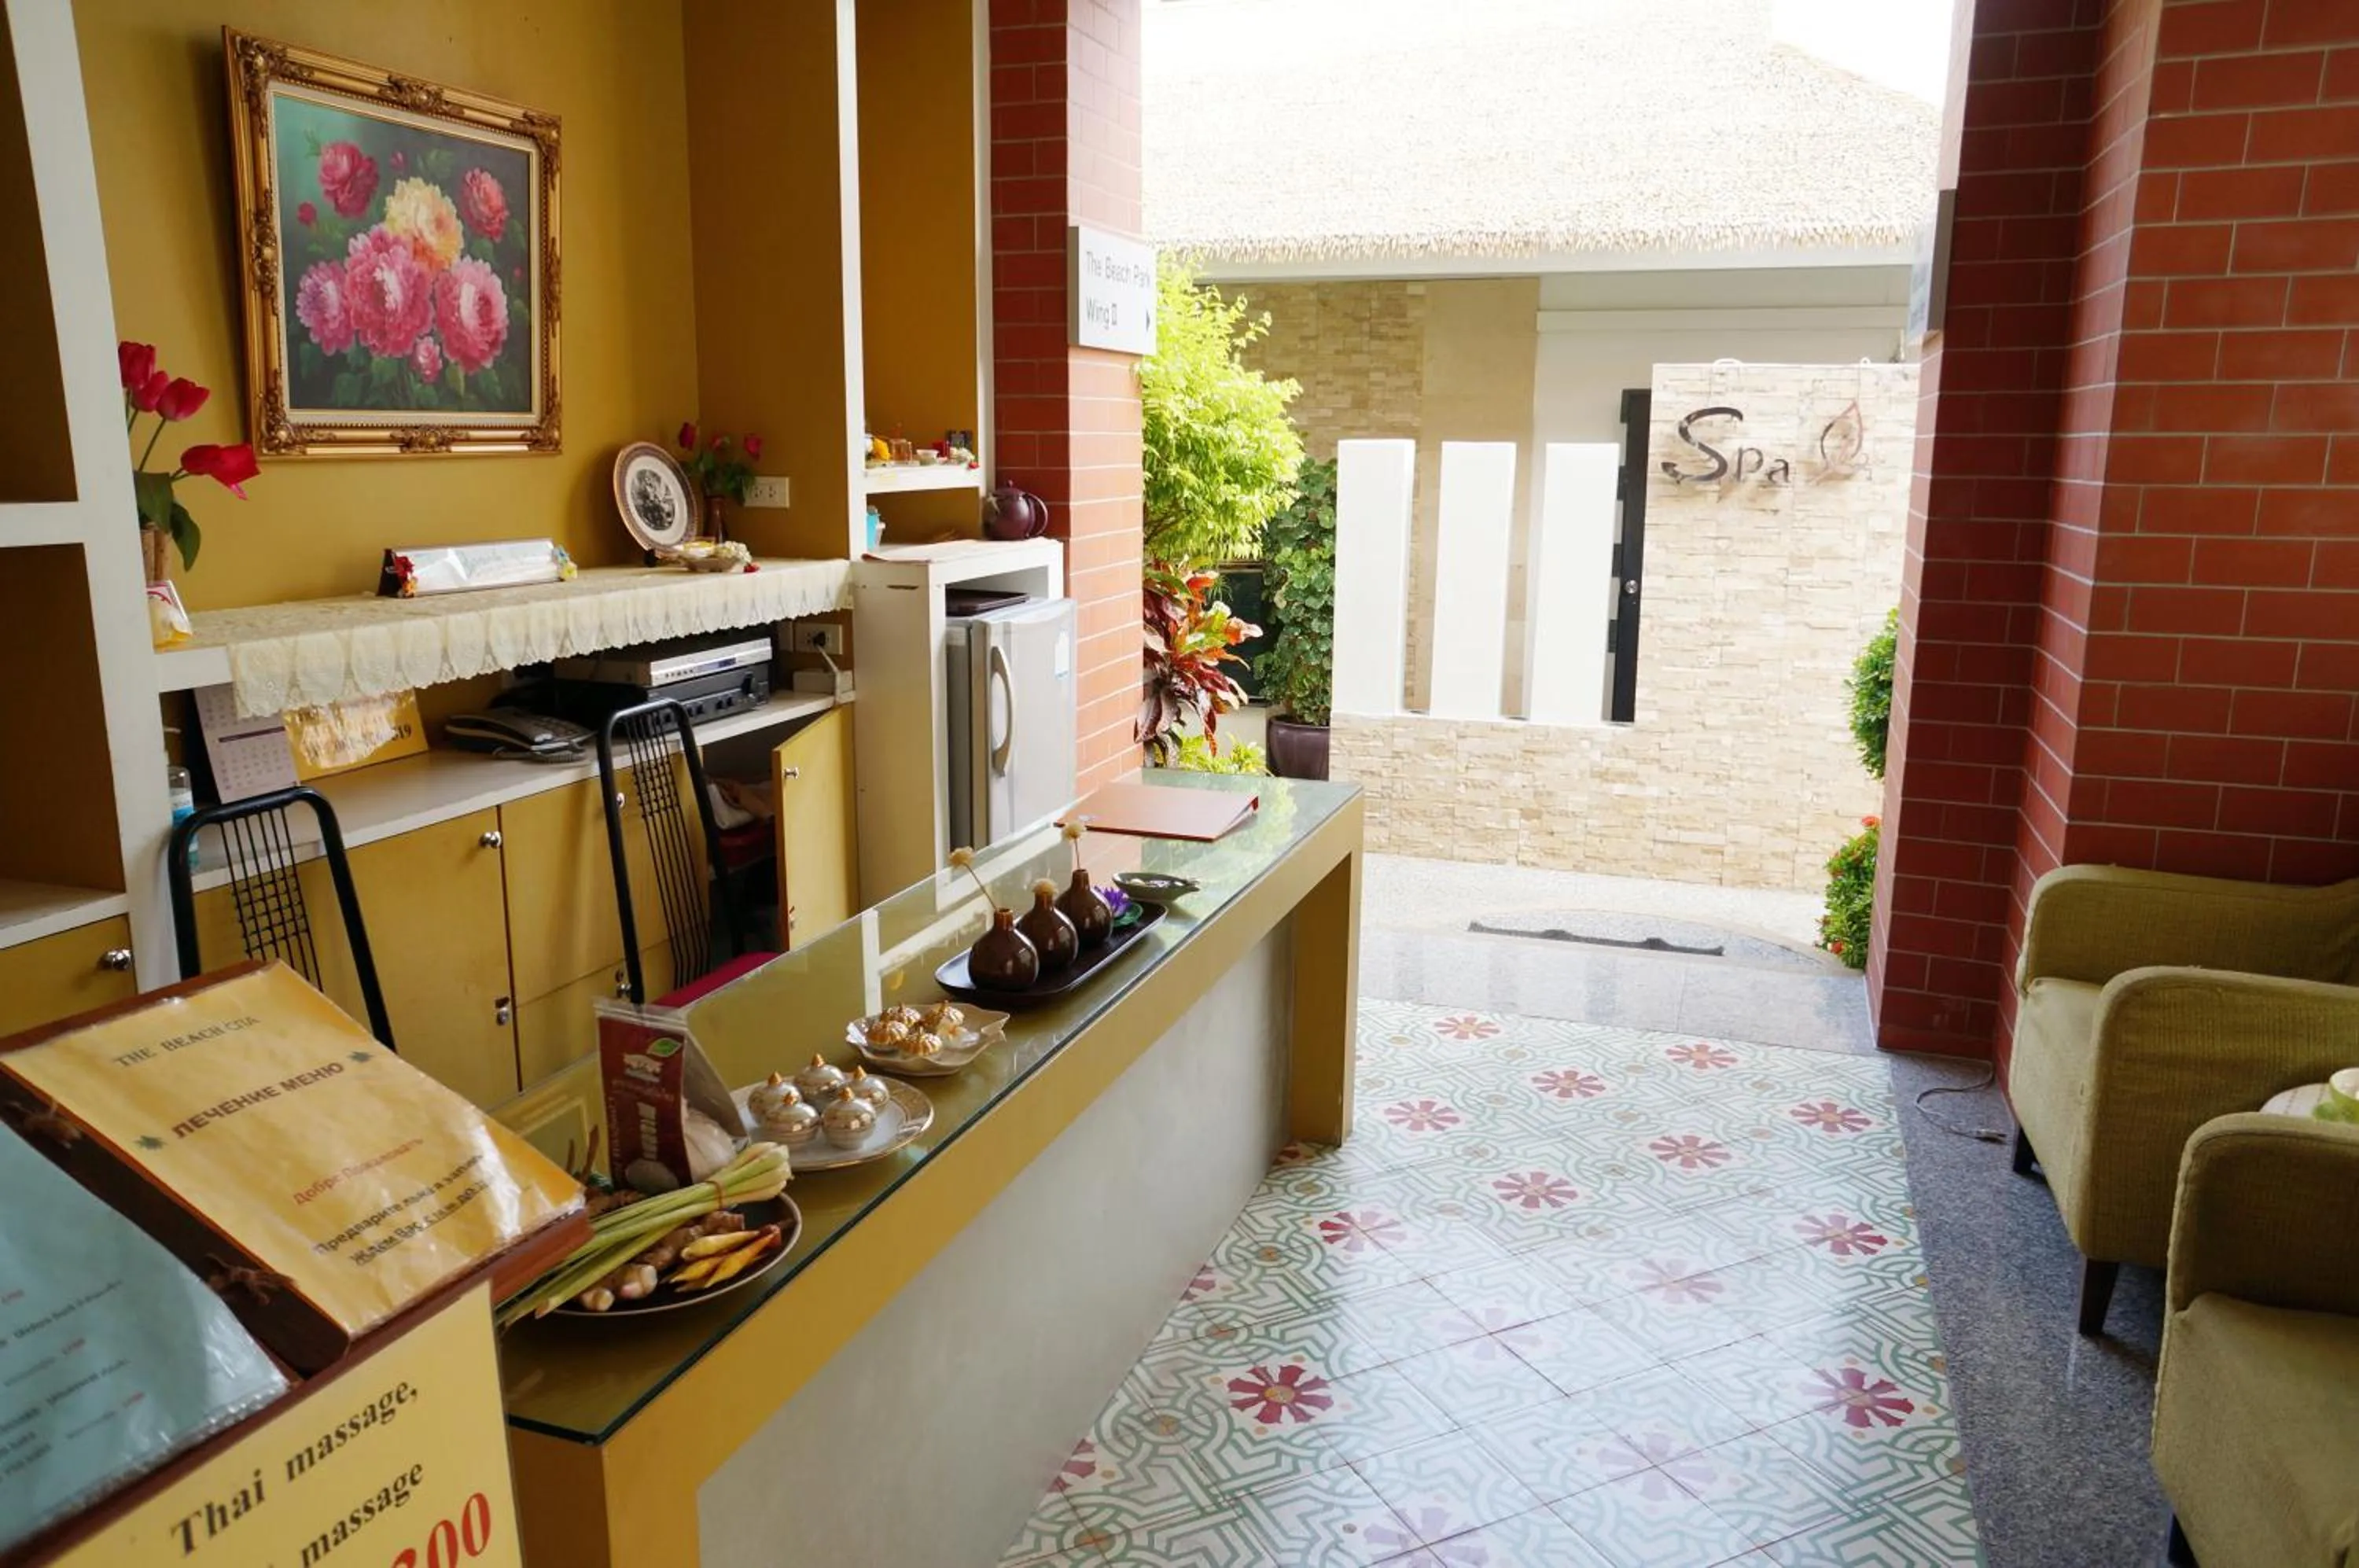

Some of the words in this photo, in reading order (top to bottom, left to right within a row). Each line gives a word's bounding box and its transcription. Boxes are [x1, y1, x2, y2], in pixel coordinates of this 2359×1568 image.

[1086, 251, 1102, 278] The
[1105, 256, 1131, 284] Beach
[1086, 296, 1110, 330] Wing
[1661, 406, 1790, 485] Spa
[115, 1047, 157, 1068] THE
[160, 1026, 226, 1052] BEACH
[279, 1062, 345, 1092] МЕНЮ
[170, 1469, 266, 1559] Thai
[285, 1381, 418, 1482] massage,
[300, 1463, 424, 1568] massage
